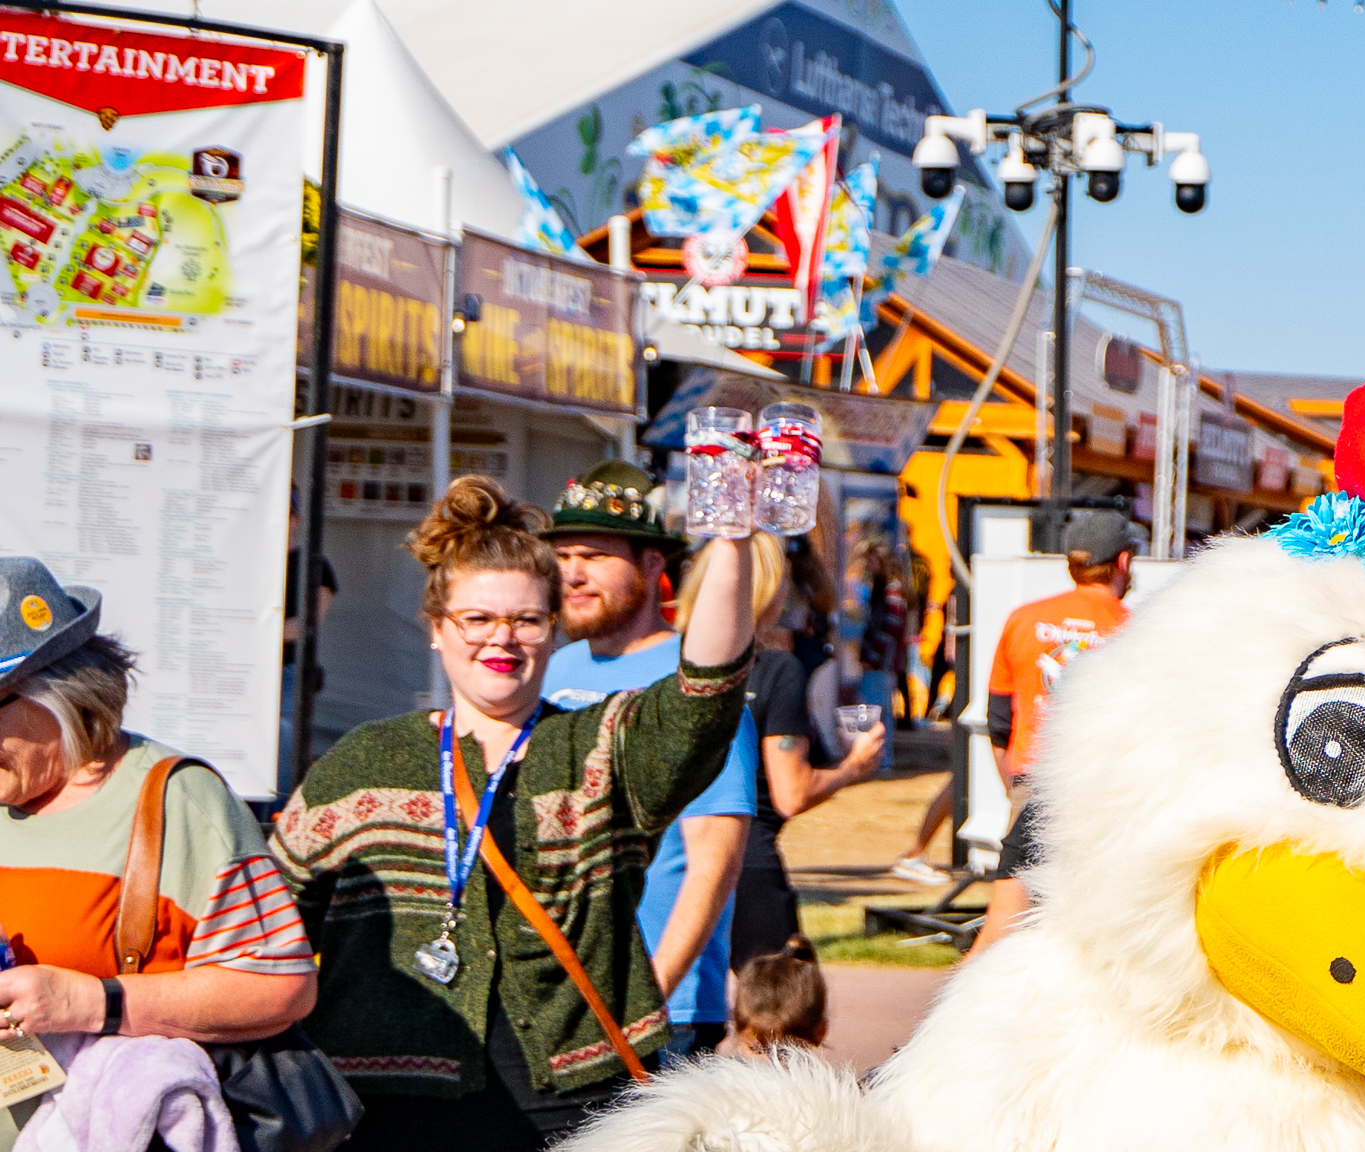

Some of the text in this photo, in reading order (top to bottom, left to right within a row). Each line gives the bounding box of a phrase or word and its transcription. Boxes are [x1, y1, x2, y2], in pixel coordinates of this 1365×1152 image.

[0, 30, 275, 94] TERTAINMENT
[337, 279, 440, 385] SPIRITS
[642, 281, 808, 329] LMUT
[683, 324, 782, 350] UDEL
